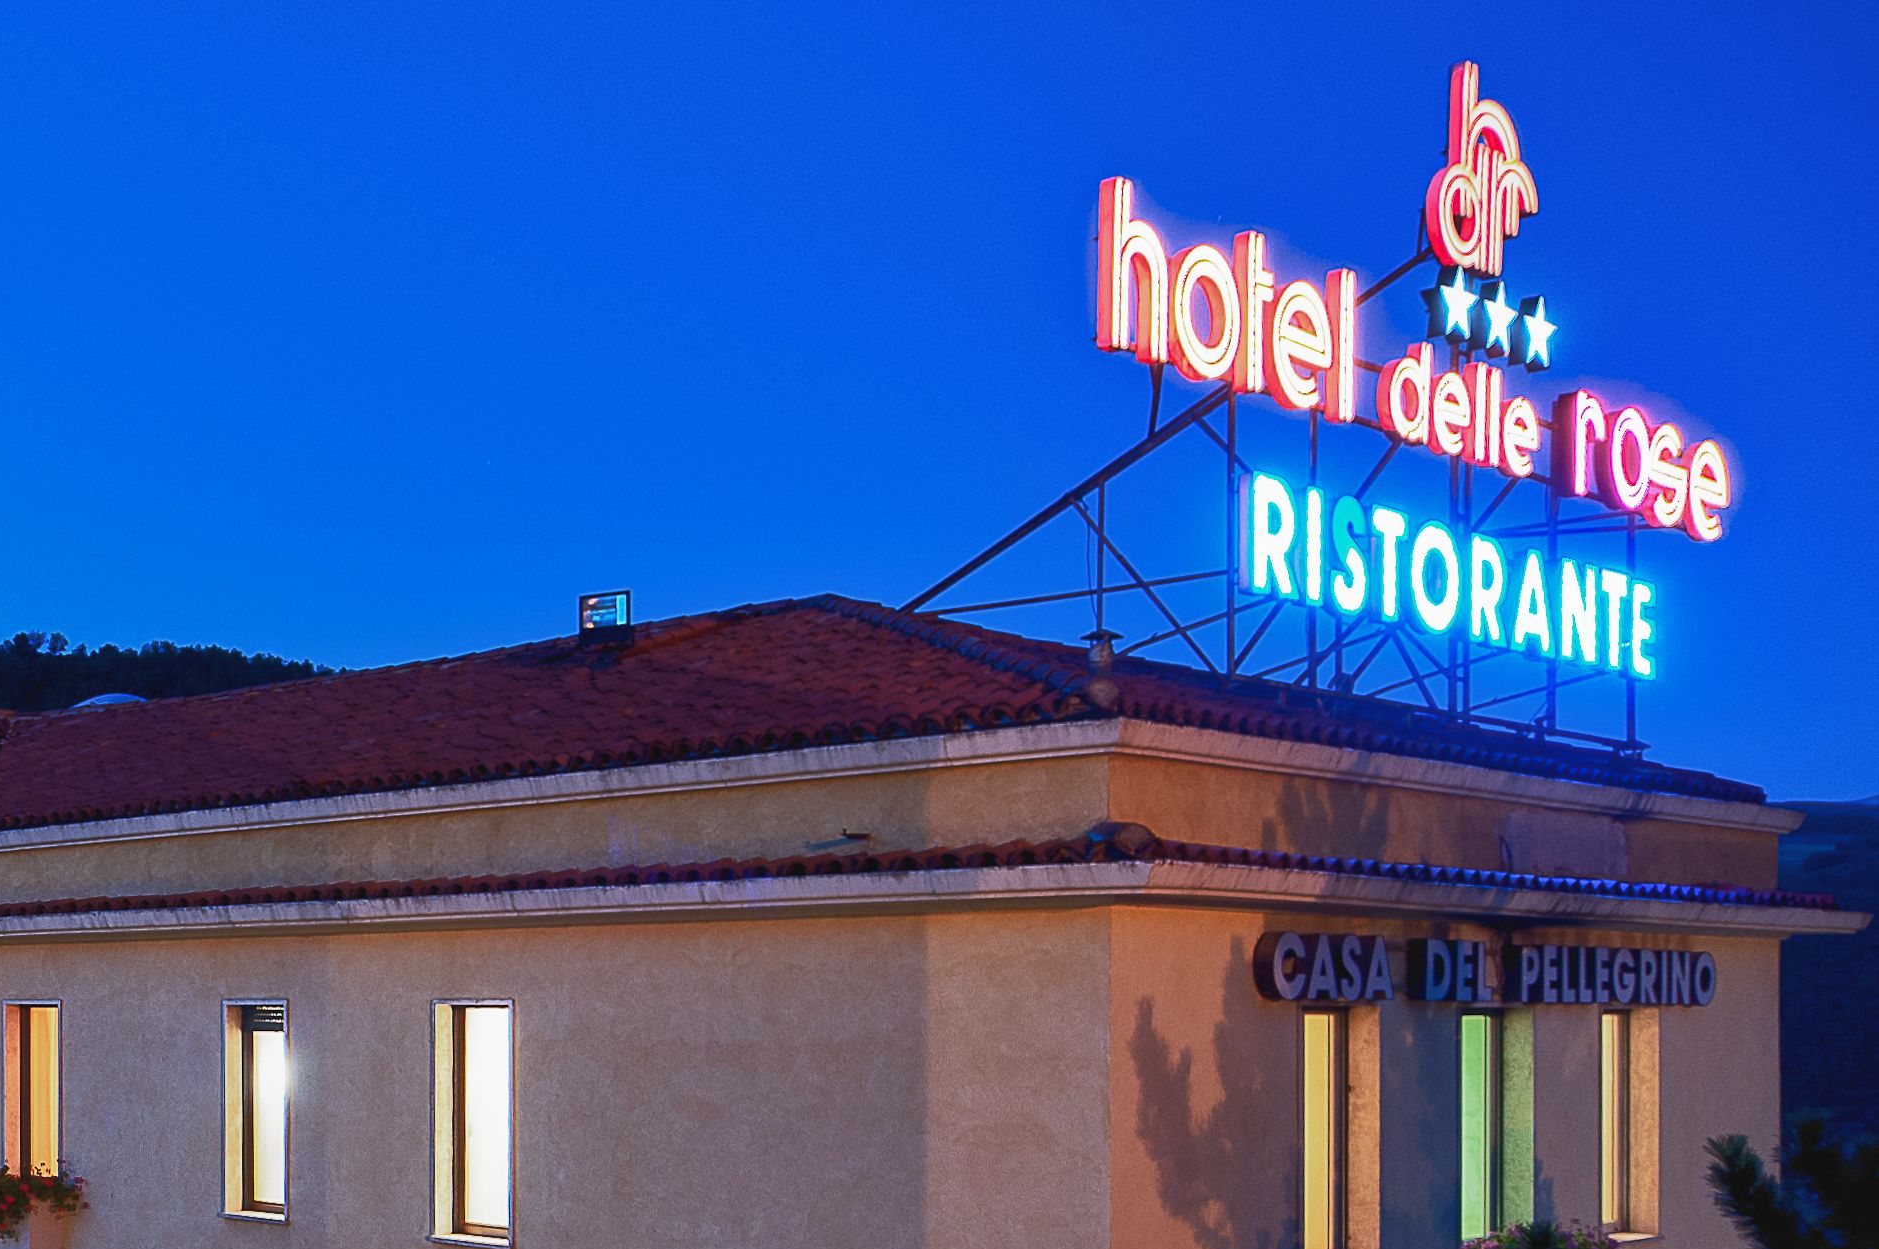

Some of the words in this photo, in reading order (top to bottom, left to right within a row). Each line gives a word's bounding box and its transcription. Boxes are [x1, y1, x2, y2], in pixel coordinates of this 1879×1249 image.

[1098, 176, 1357, 423] hotel
[1379, 342, 1539, 478] delle
[1556, 388, 1730, 541] rose
[1244, 469, 1655, 680] RISTORANTE
[1267, 931, 1394, 1001] CASA
[1422, 939, 1493, 1002] DEL
[1518, 943, 1717, 1006] PELLEGRINO
